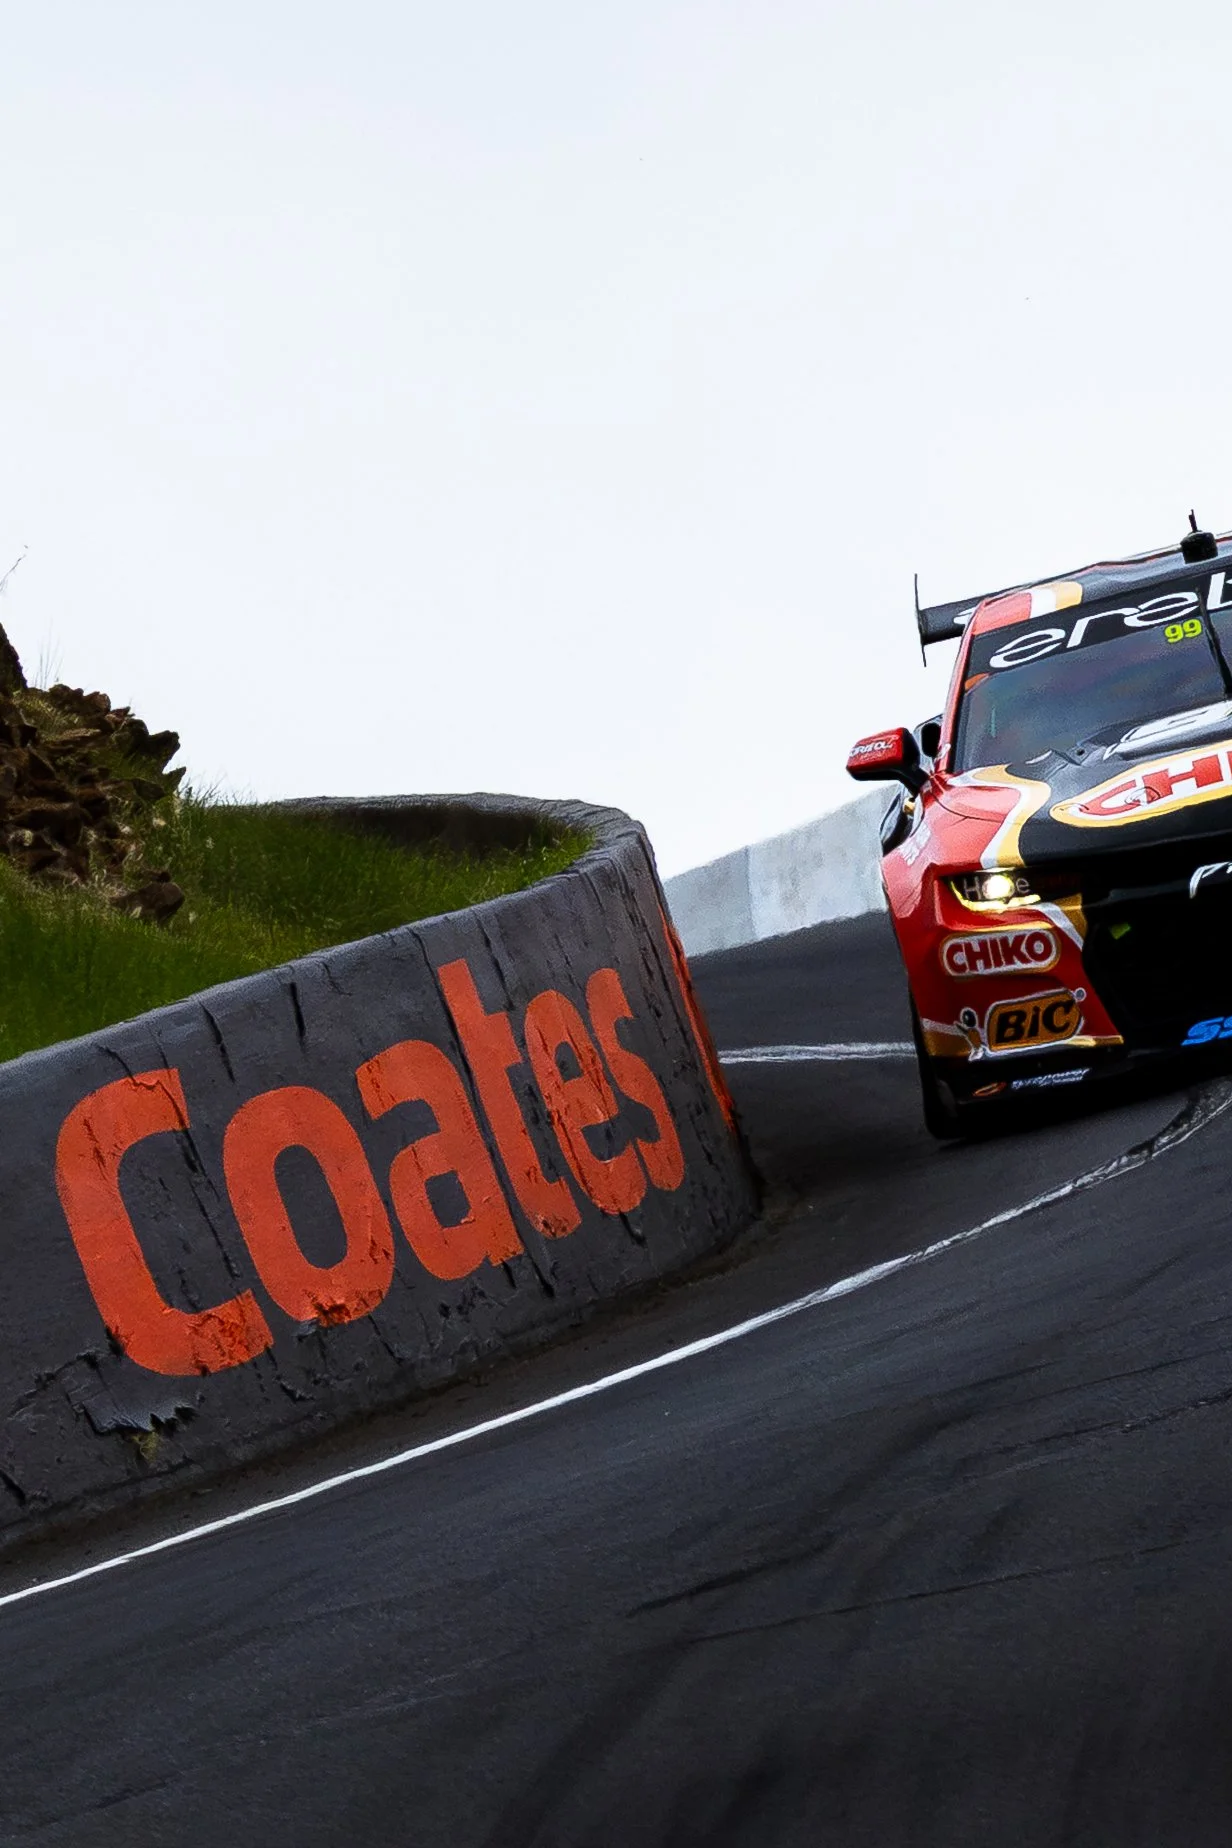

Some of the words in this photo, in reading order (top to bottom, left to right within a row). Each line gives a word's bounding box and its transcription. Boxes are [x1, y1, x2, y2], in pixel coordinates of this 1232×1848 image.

[1164, 619, 1202, 643] 99
[963, 874, 1031, 901] He
[946, 931, 1054, 975] CHIKO
[55, 958, 687, 1377] Coates
